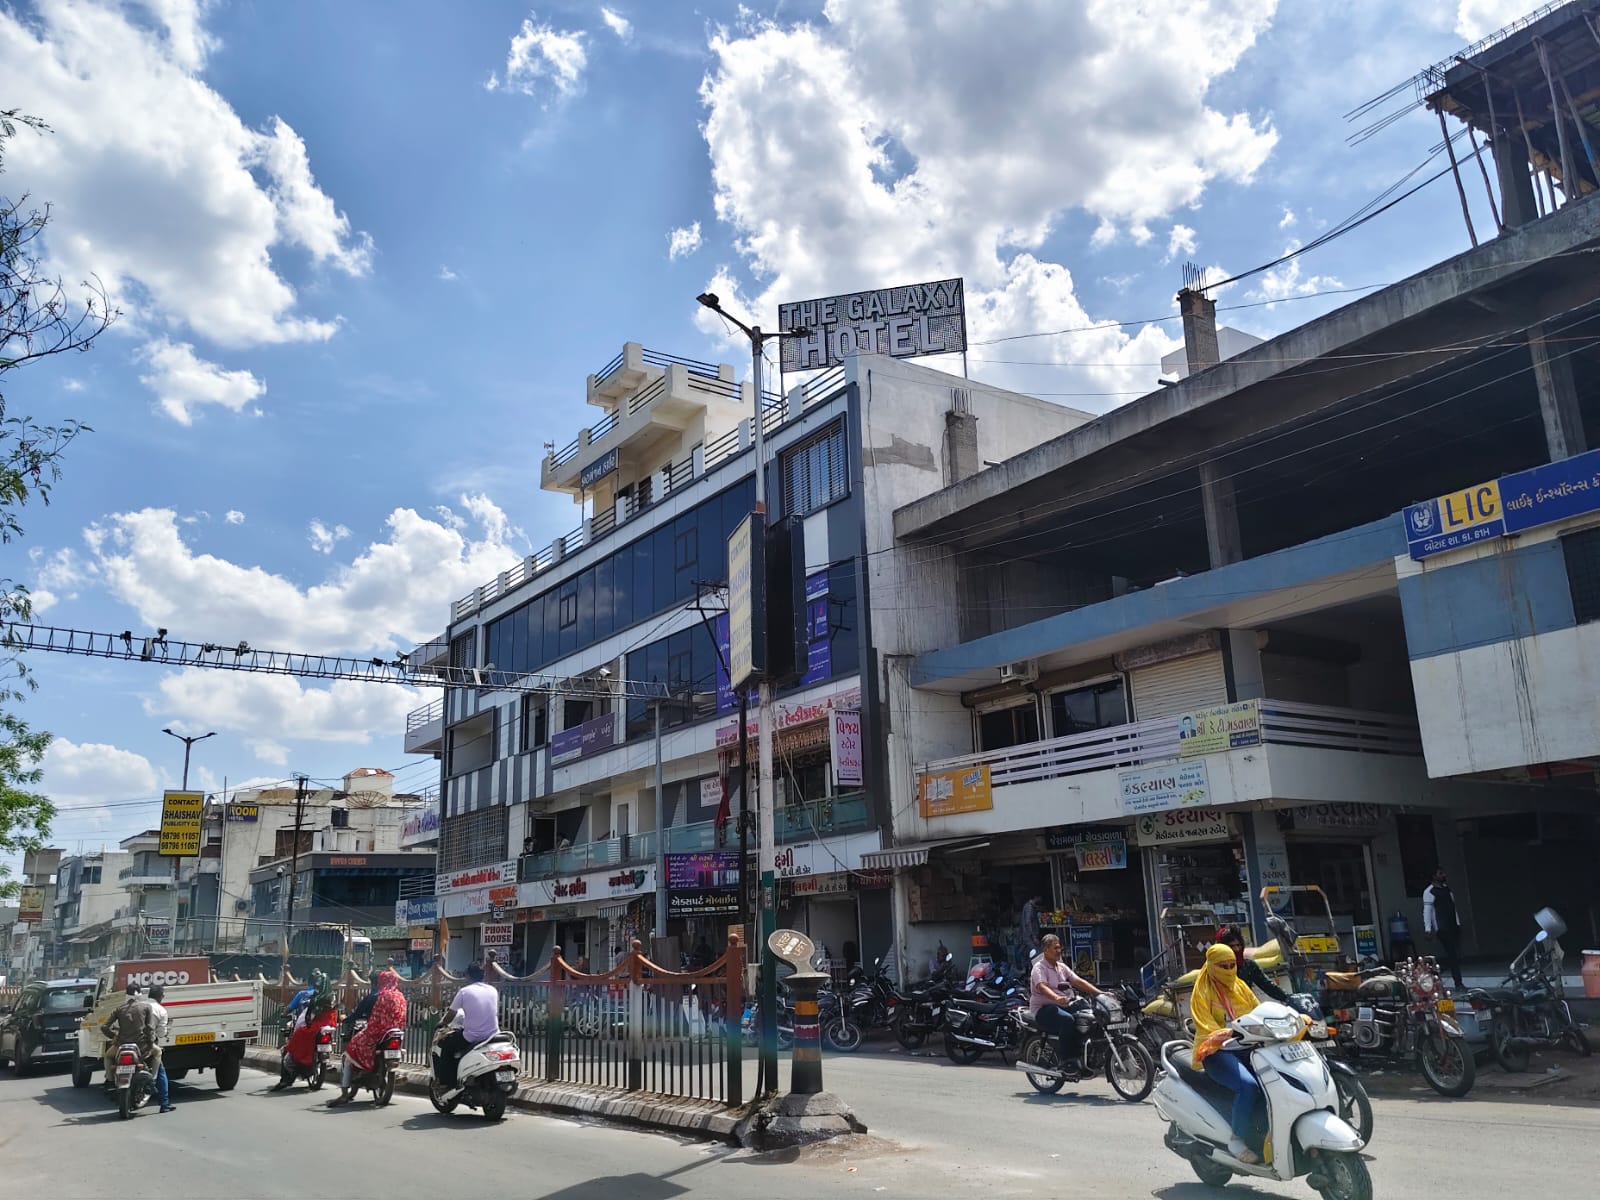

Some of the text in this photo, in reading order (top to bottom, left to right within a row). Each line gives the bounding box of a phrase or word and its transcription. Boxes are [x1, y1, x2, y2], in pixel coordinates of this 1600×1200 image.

[781, 280, 959, 330] THE GALAXY
[800, 315, 946, 368] HOTEL
[1445, 487, 1495, 527] LIC
[1132, 776, 1177, 795] કલ્યાણ
[164, 810, 201, 819] SHAISHAV
[229, 806, 257, 816] ROOM
[484, 925, 512, 934] PHONE
[484, 935, 512, 944] HOUSE
[127, 970, 190, 986] HOCCO
